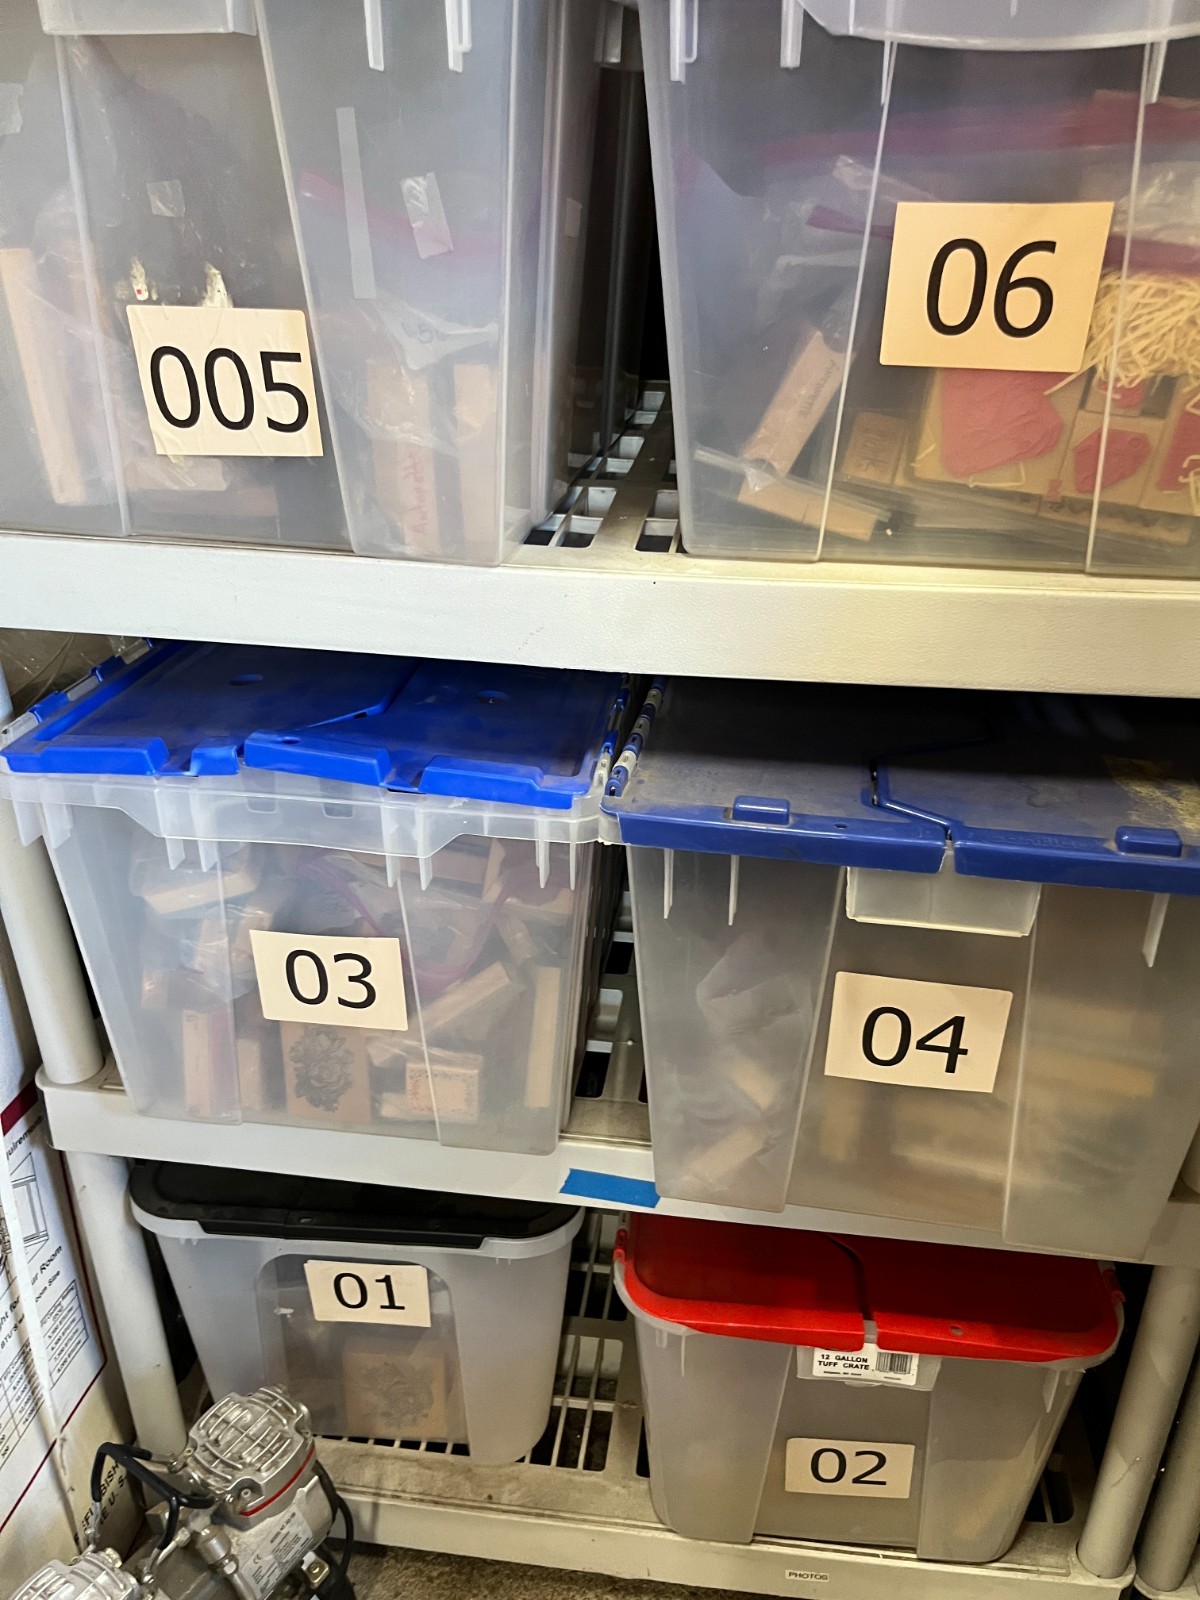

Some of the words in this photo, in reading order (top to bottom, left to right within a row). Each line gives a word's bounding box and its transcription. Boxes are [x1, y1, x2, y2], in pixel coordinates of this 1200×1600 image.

[926, 238, 1057, 338] 06
[150, 345, 309, 433] 005
[285, 949, 376, 1009] 03
[862, 1006, 969, 1074] 04
[333, 1272, 406, 1311] 01
[818, 1360, 839, 1368] TUFF
[842, 1362, 870, 1371] CRATE
[834, 1354, 868, 1364] GALLON
[810, 1447, 887, 1486] 02
[788, 1571, 828, 1581] PHOTOS
